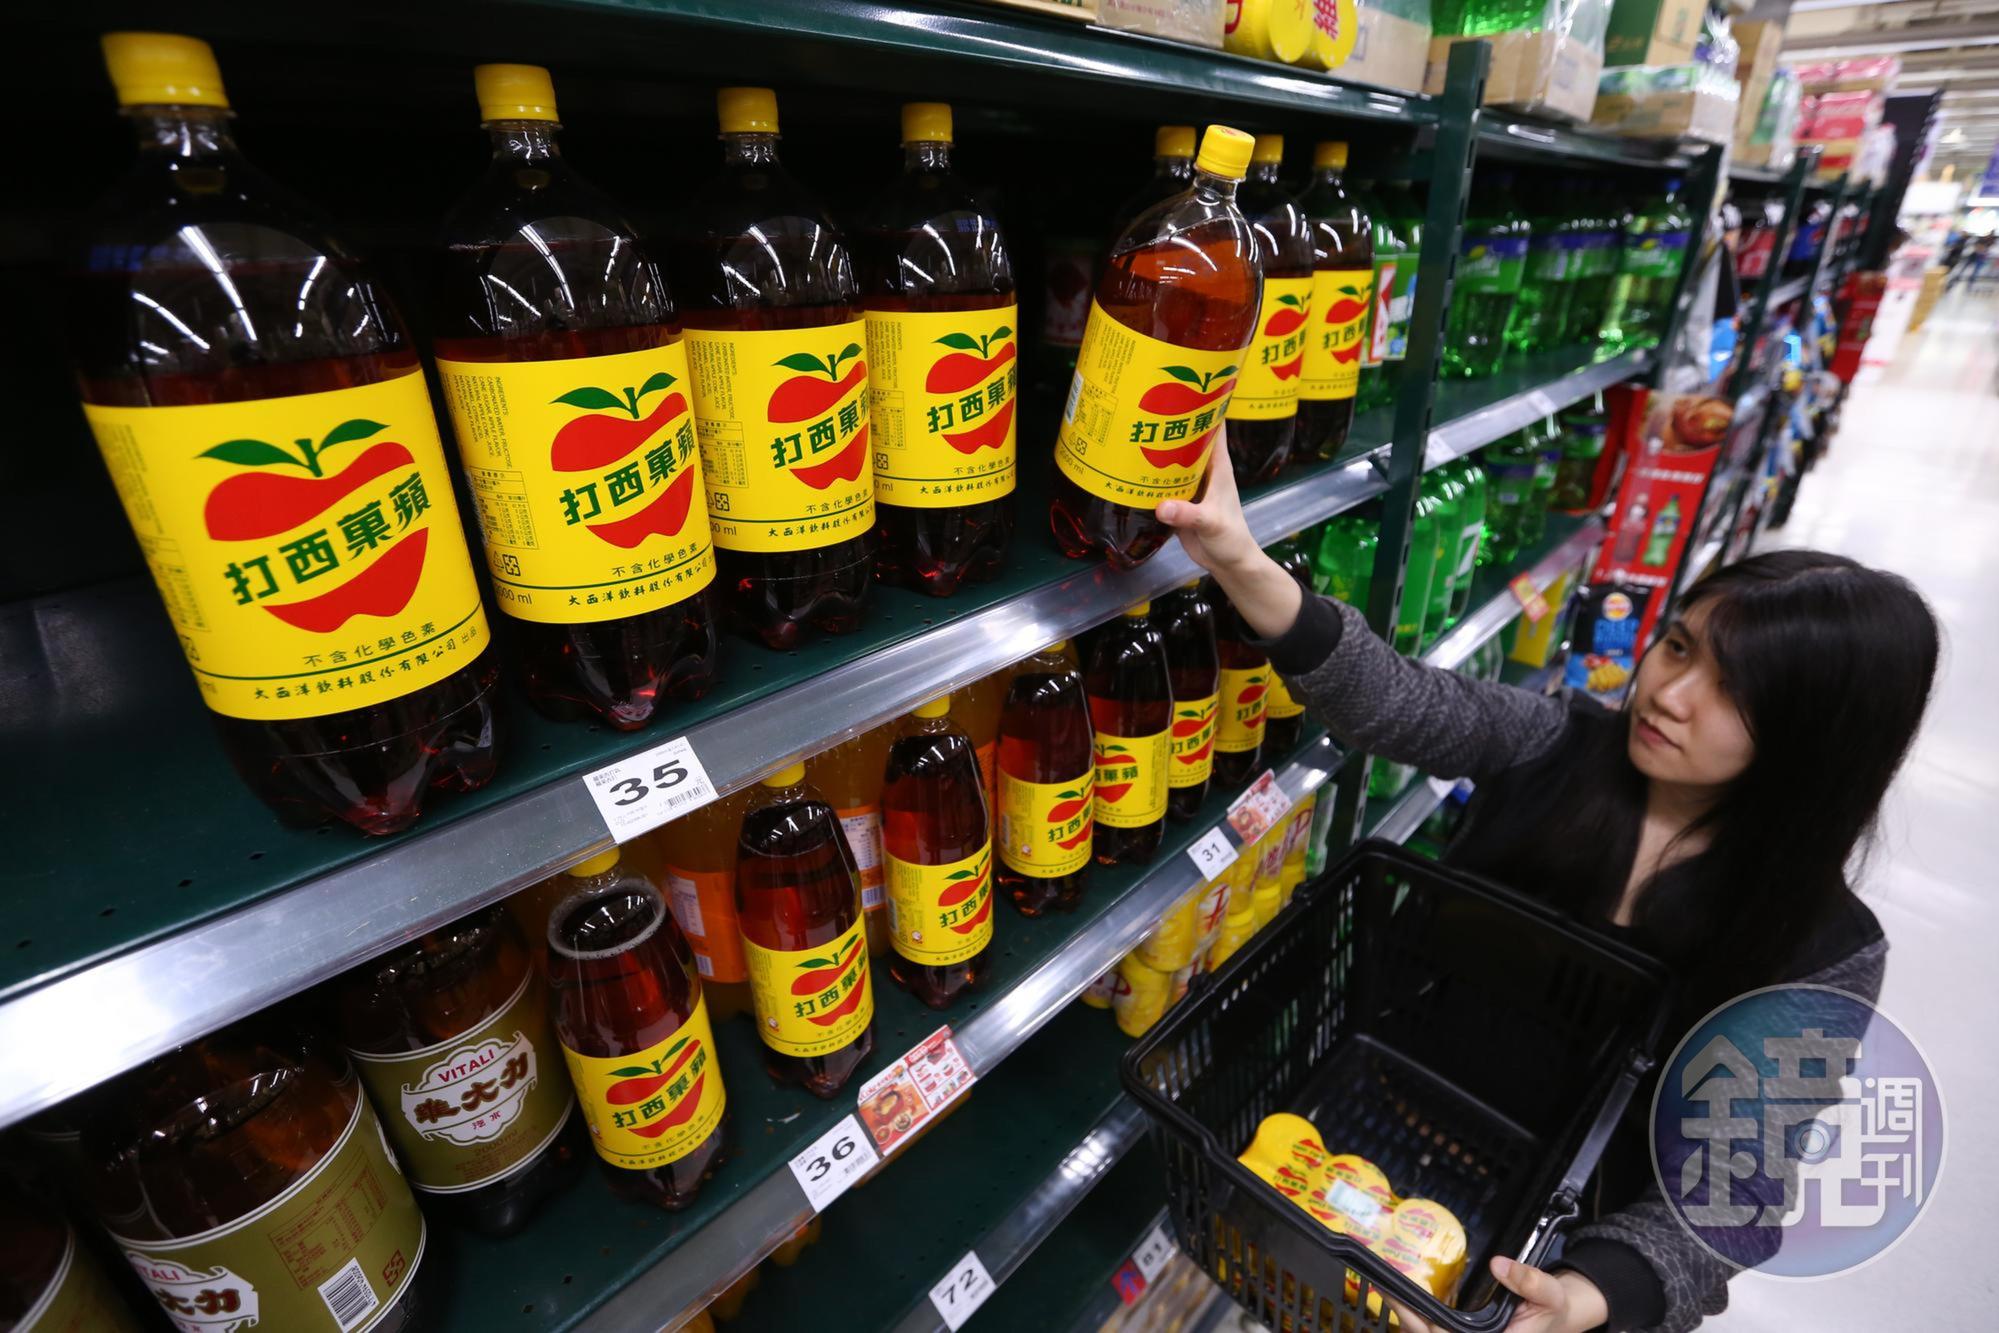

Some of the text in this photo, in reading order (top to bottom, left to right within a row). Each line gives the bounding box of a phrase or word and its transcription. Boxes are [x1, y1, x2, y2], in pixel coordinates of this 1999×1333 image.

[518, 593, 532, 605] ml
[303, 621, 437, 667] 不含化學色素
[608, 758, 689, 807] 35
[1202, 842, 1221, 862] 31
[438, 1049, 495, 1083] VITALI
[806, 1136, 856, 1182] 36
[941, 1268, 978, 1305] 72
